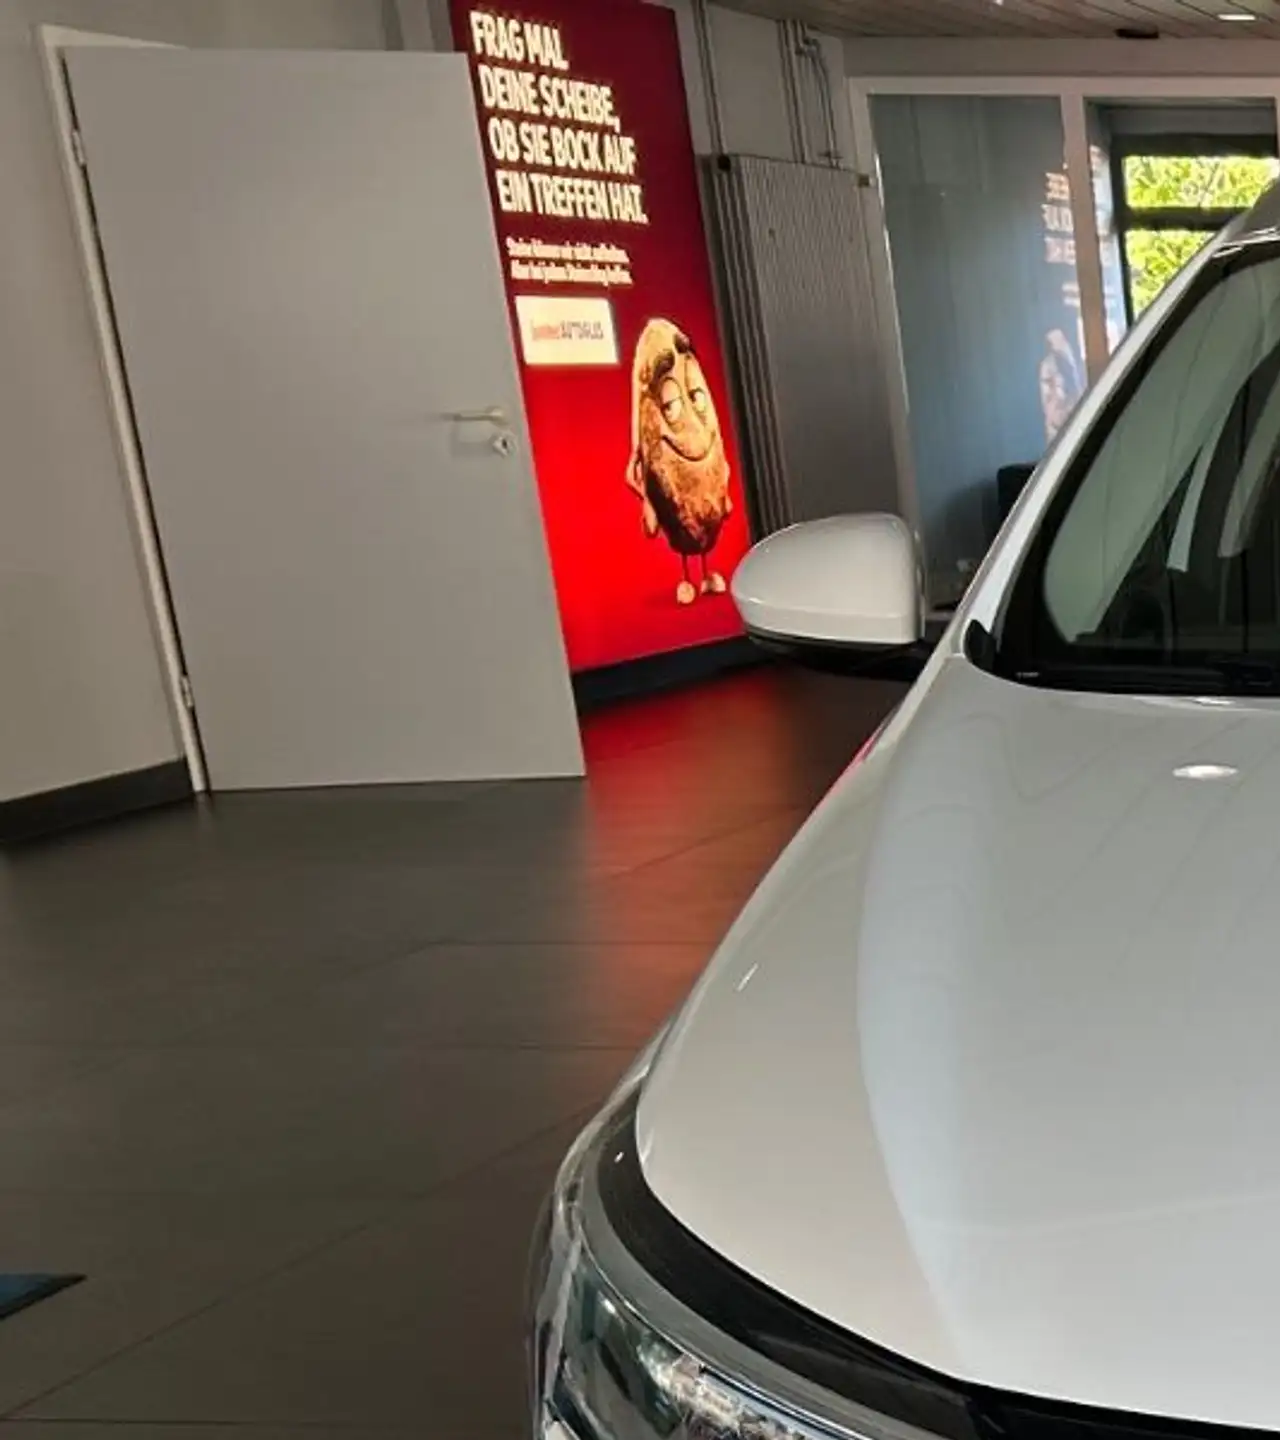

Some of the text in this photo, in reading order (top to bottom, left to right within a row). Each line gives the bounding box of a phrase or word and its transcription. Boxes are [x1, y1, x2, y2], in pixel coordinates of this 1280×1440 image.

[470, 11, 569, 70] FRAG MAL
[478, 64, 621, 133] DEINE SCHEIBE,
[488, 117, 637, 175] OB SIE BOCK AUF
[495, 169, 649, 224] EIN TREFFEN HAT.
